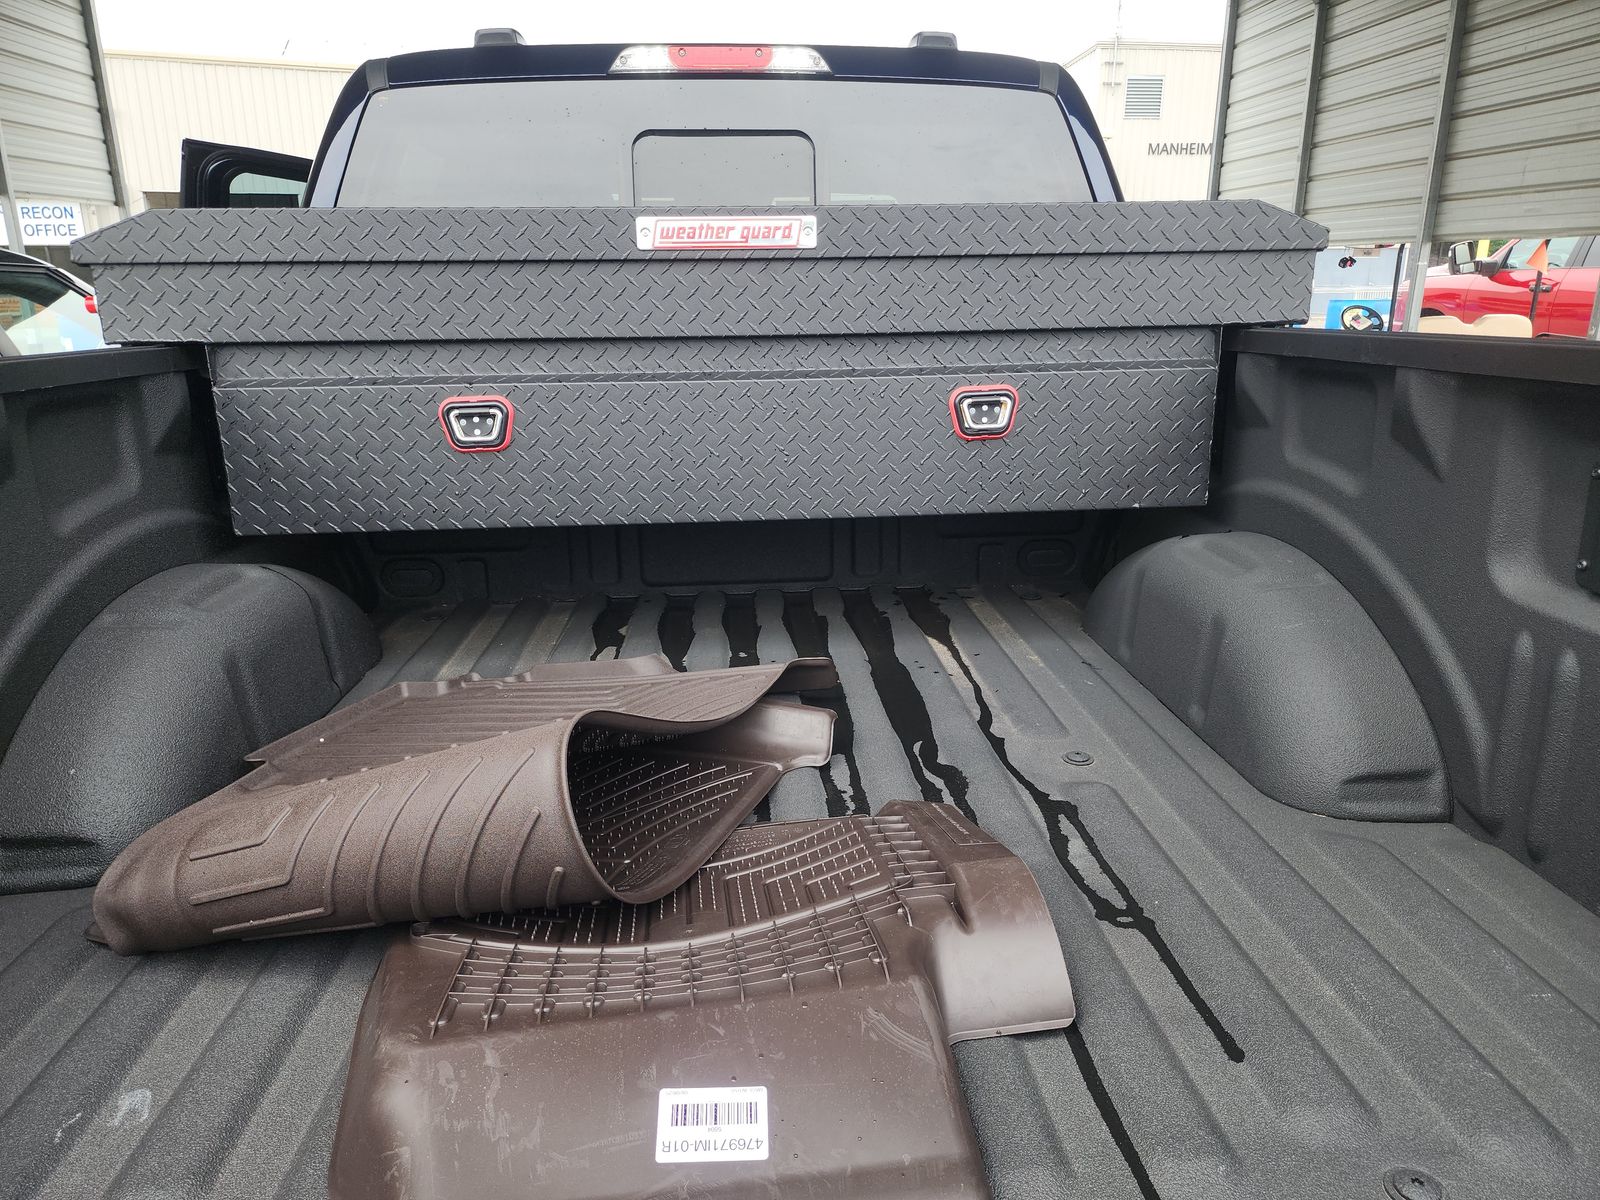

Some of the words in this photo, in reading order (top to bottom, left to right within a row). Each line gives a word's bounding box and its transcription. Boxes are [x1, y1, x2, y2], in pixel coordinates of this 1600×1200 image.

[1147, 142, 1213, 156] MANHEIM
[20, 206, 74, 219] RECON
[23, 223, 78, 237] OFFICE
[659, 223, 736, 240] weather
[740, 222, 793, 243] guard
[661, 1137, 764, 1153] 476971IM-01R
